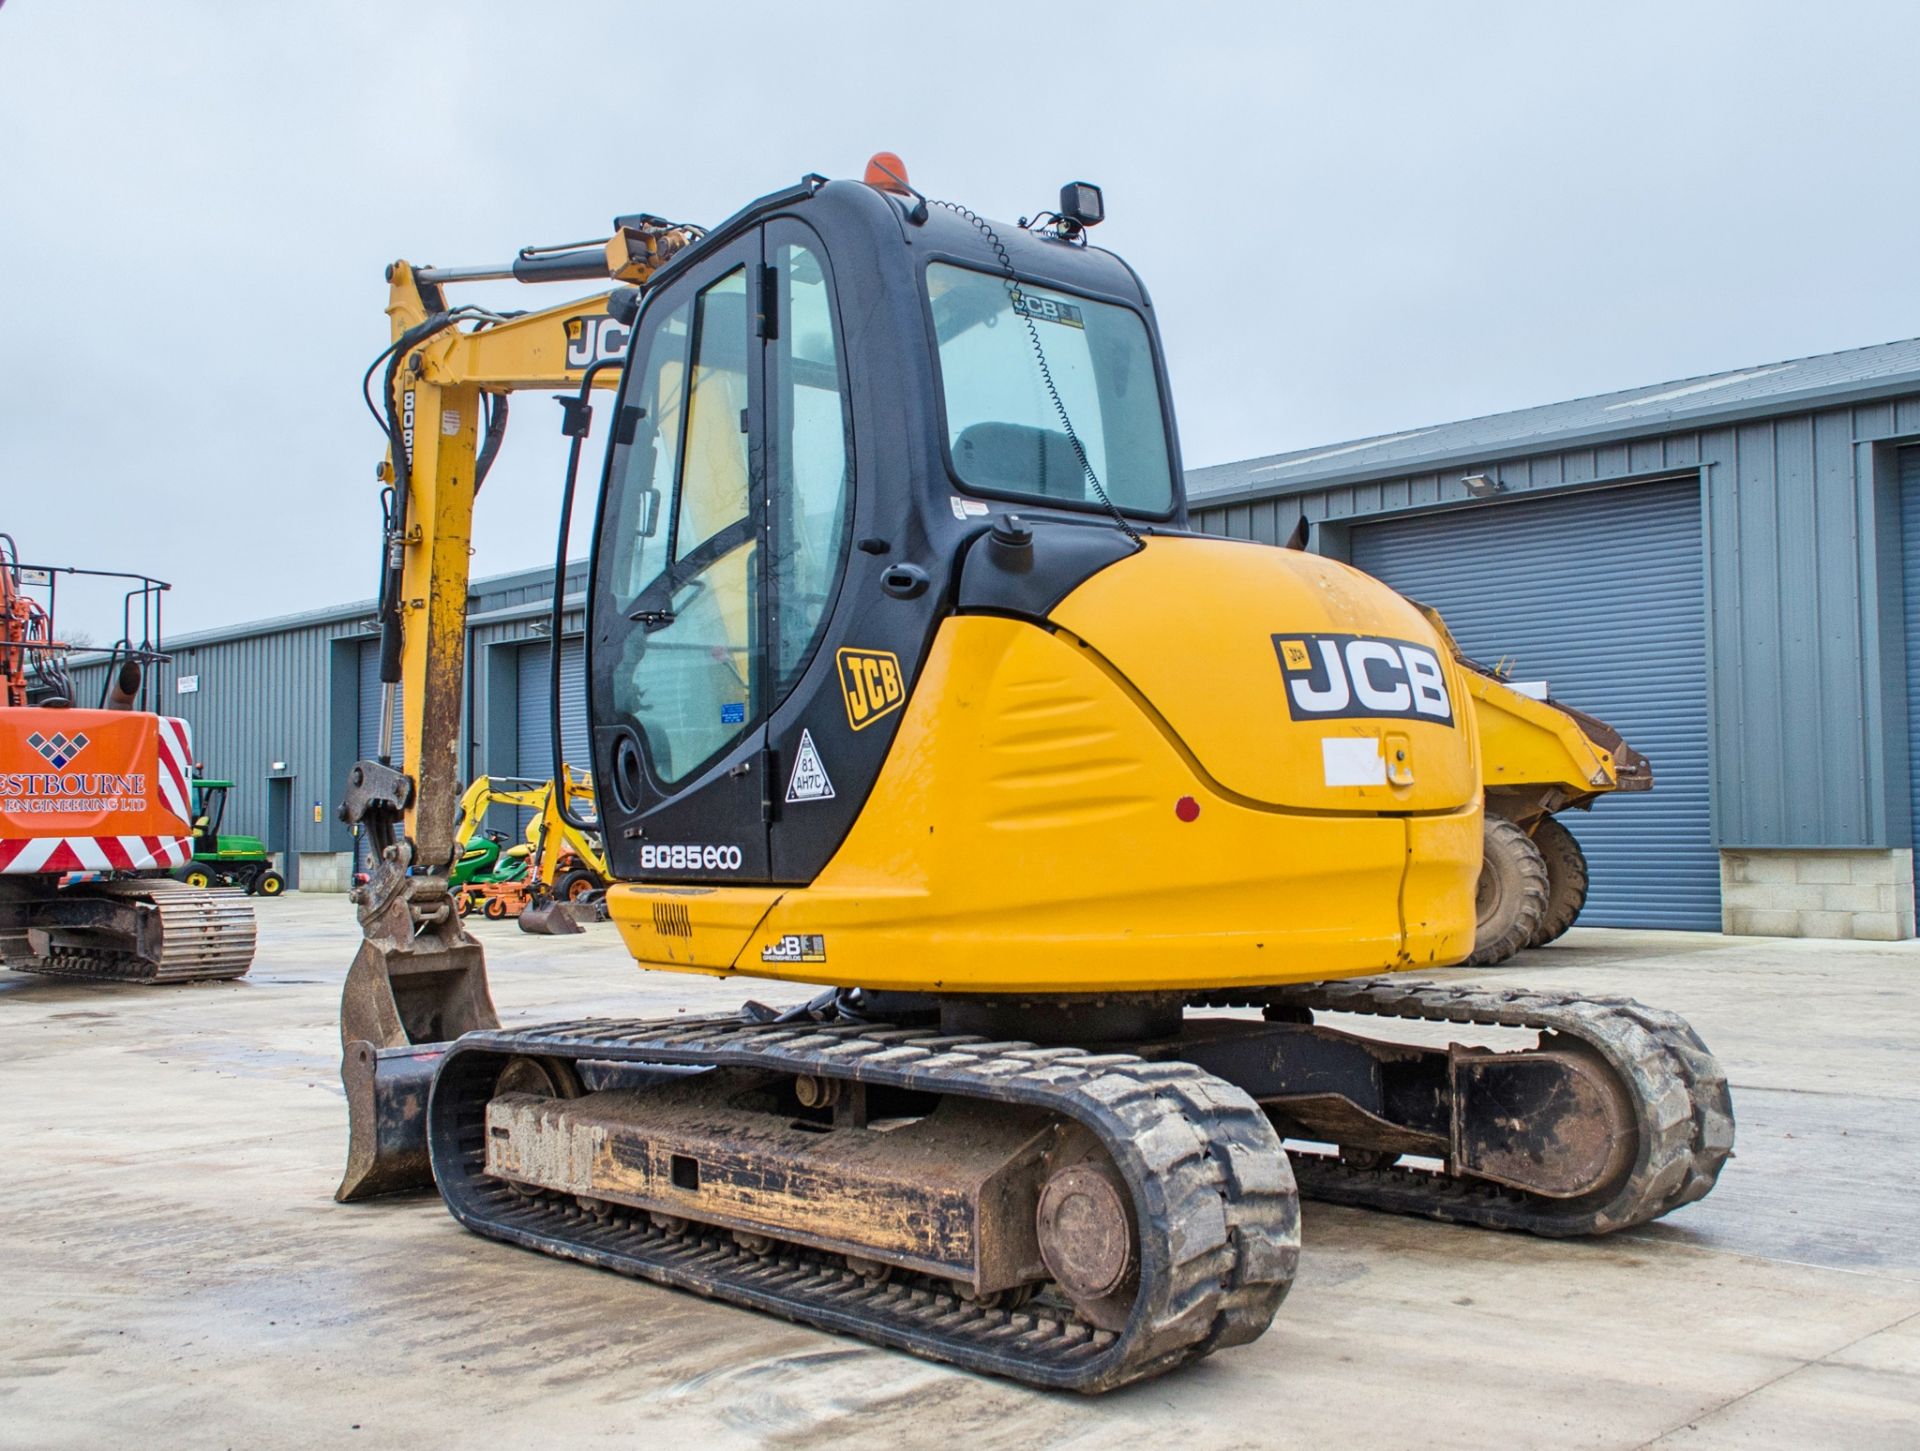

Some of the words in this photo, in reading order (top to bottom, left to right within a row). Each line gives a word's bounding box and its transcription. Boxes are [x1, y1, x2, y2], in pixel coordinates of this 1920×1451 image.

[1290, 640, 1452, 718] JCB
[846, 656, 900, 721] JCB
[801, 757, 814, 773] 81
[796, 774, 822, 791] AH7C
[4, 798, 119, 813] ENGINEERING
[120, 798, 147, 812] LTD
